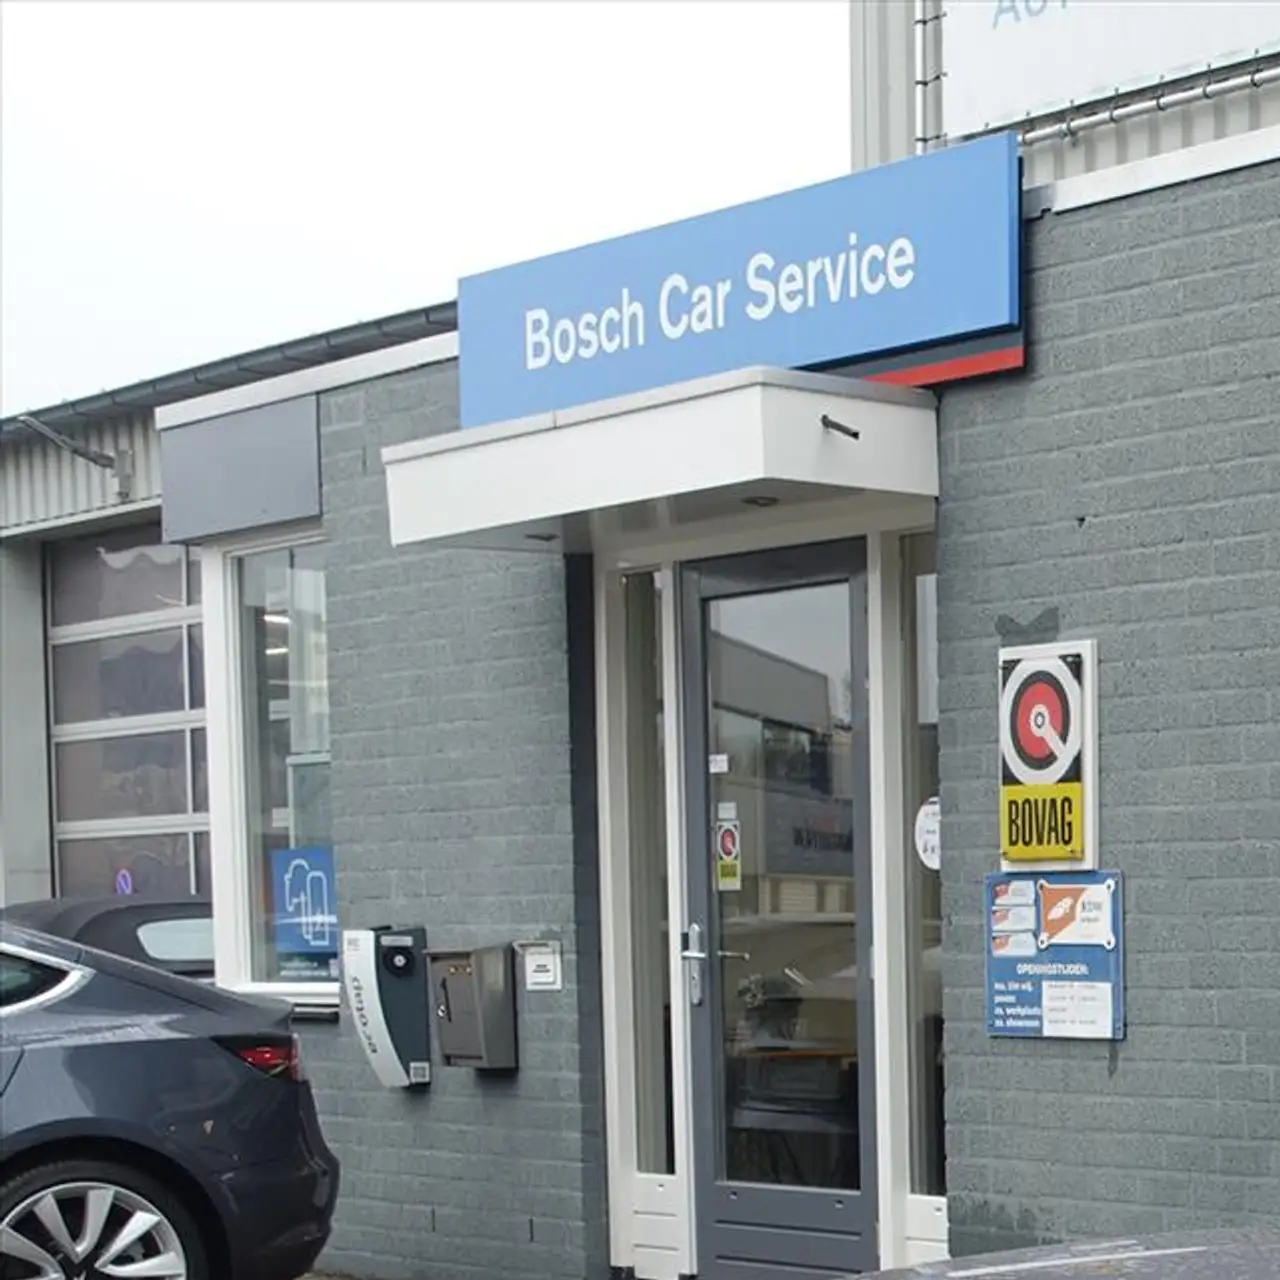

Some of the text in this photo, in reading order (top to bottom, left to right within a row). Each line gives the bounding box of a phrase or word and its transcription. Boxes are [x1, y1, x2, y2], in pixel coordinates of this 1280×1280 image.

[525, 232, 916, 370] Bosch Car Service
[1007, 797, 1073, 847] BOVAG
